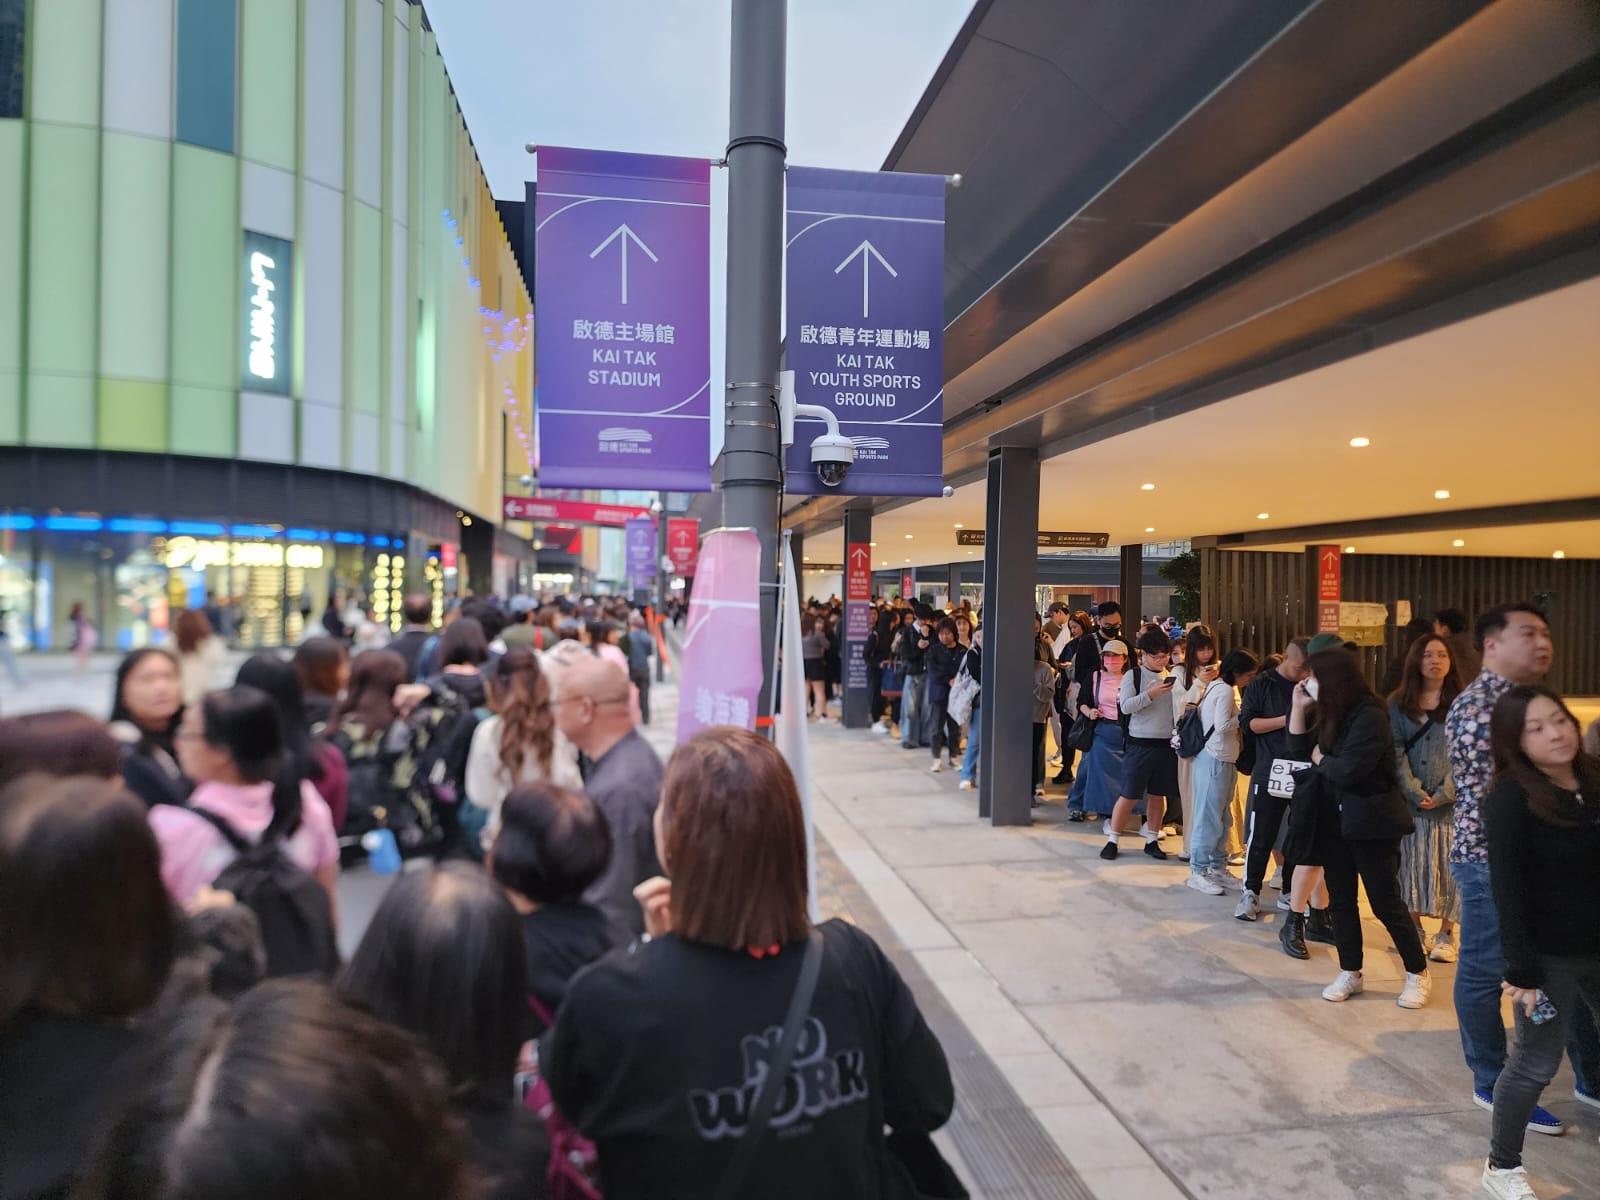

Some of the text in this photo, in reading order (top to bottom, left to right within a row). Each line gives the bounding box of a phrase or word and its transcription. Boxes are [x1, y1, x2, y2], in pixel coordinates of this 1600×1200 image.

[573, 319, 675, 345] 啟德主場館
[800, 325, 930, 350] 啟德青年運動場
[593, 349, 657, 366] KAI TAK
[836, 354, 895, 370] KAI TAK
[588, 370, 661, 387] STADIUM
[810, 372, 921, 390] YOUTH SPORTS
[835, 392, 896, 408] GROUND
